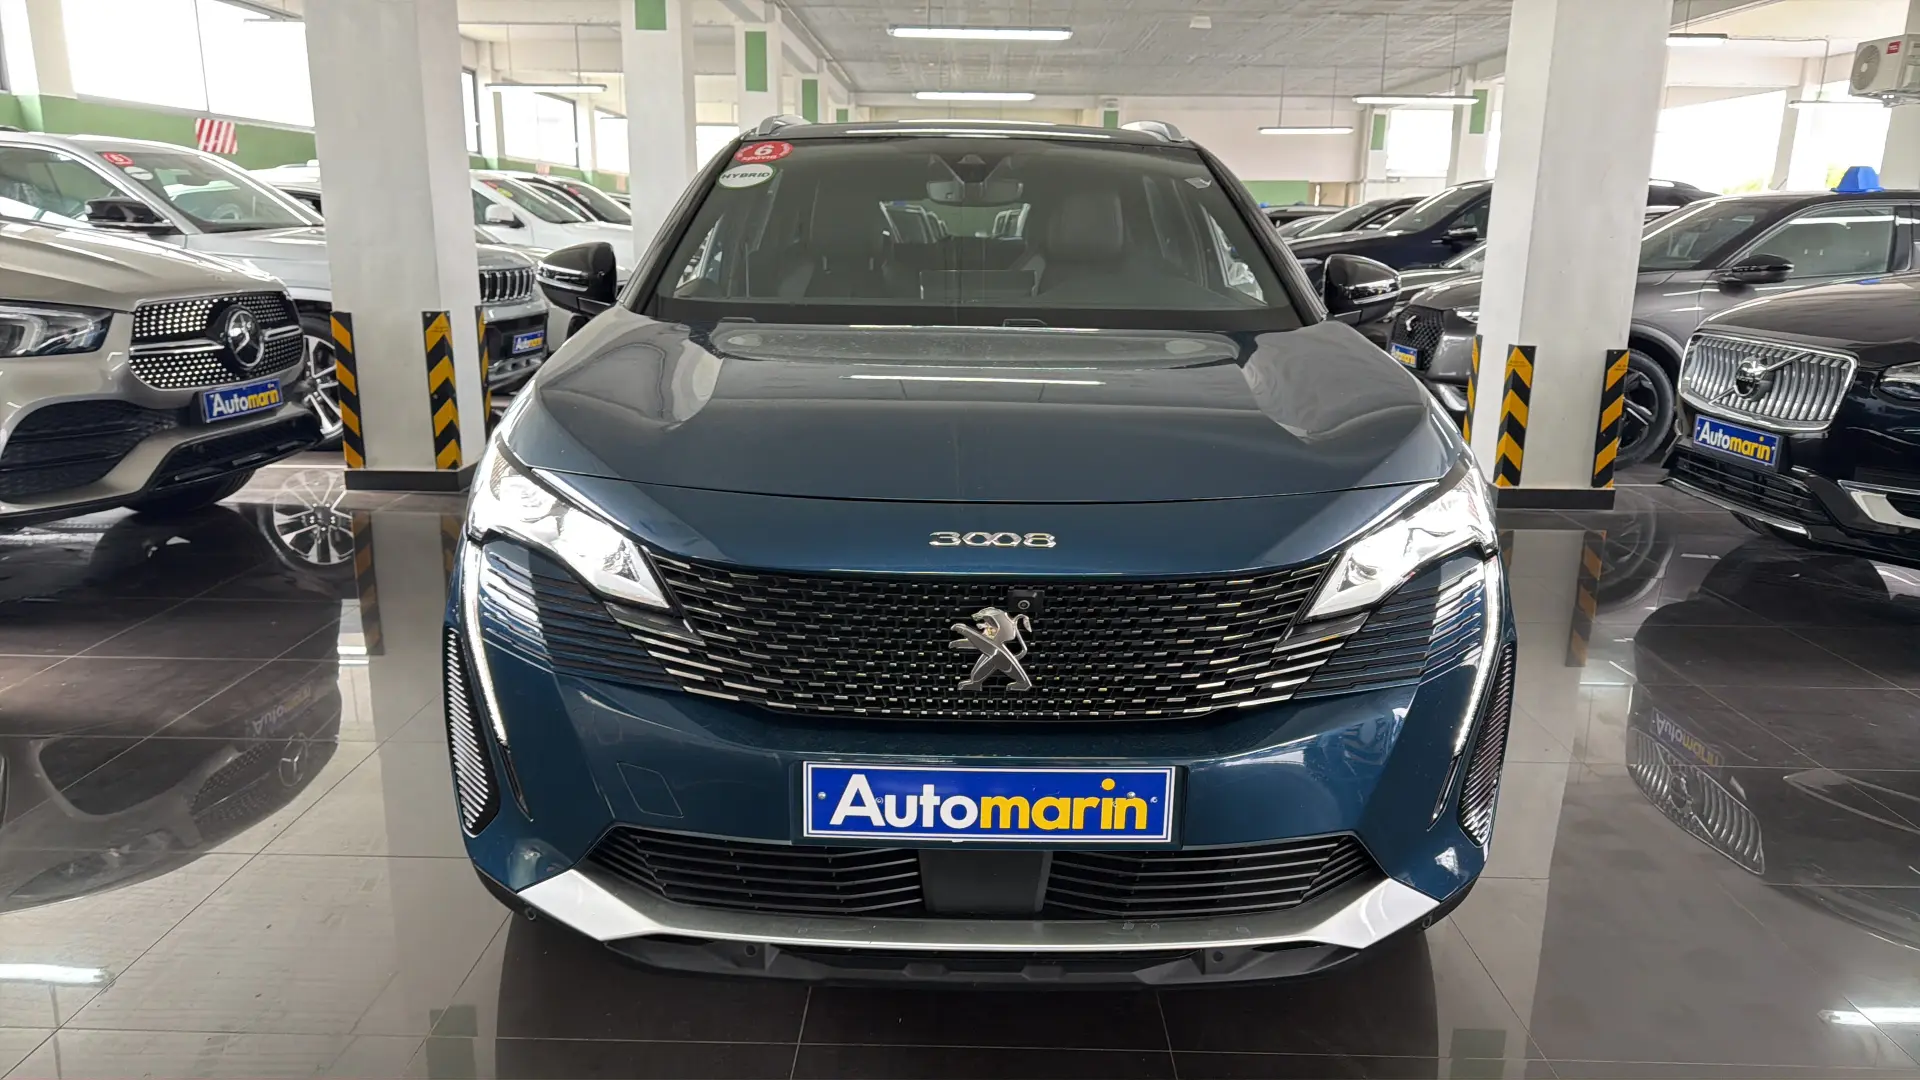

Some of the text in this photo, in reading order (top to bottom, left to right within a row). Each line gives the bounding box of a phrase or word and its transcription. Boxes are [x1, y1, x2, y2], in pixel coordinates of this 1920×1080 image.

[754, 144, 775, 156] 6
[1698, 421, 1771, 461] Automarin
[929, 531, 1056, 548] 3008
[829, 774, 1147, 830] Automarin
